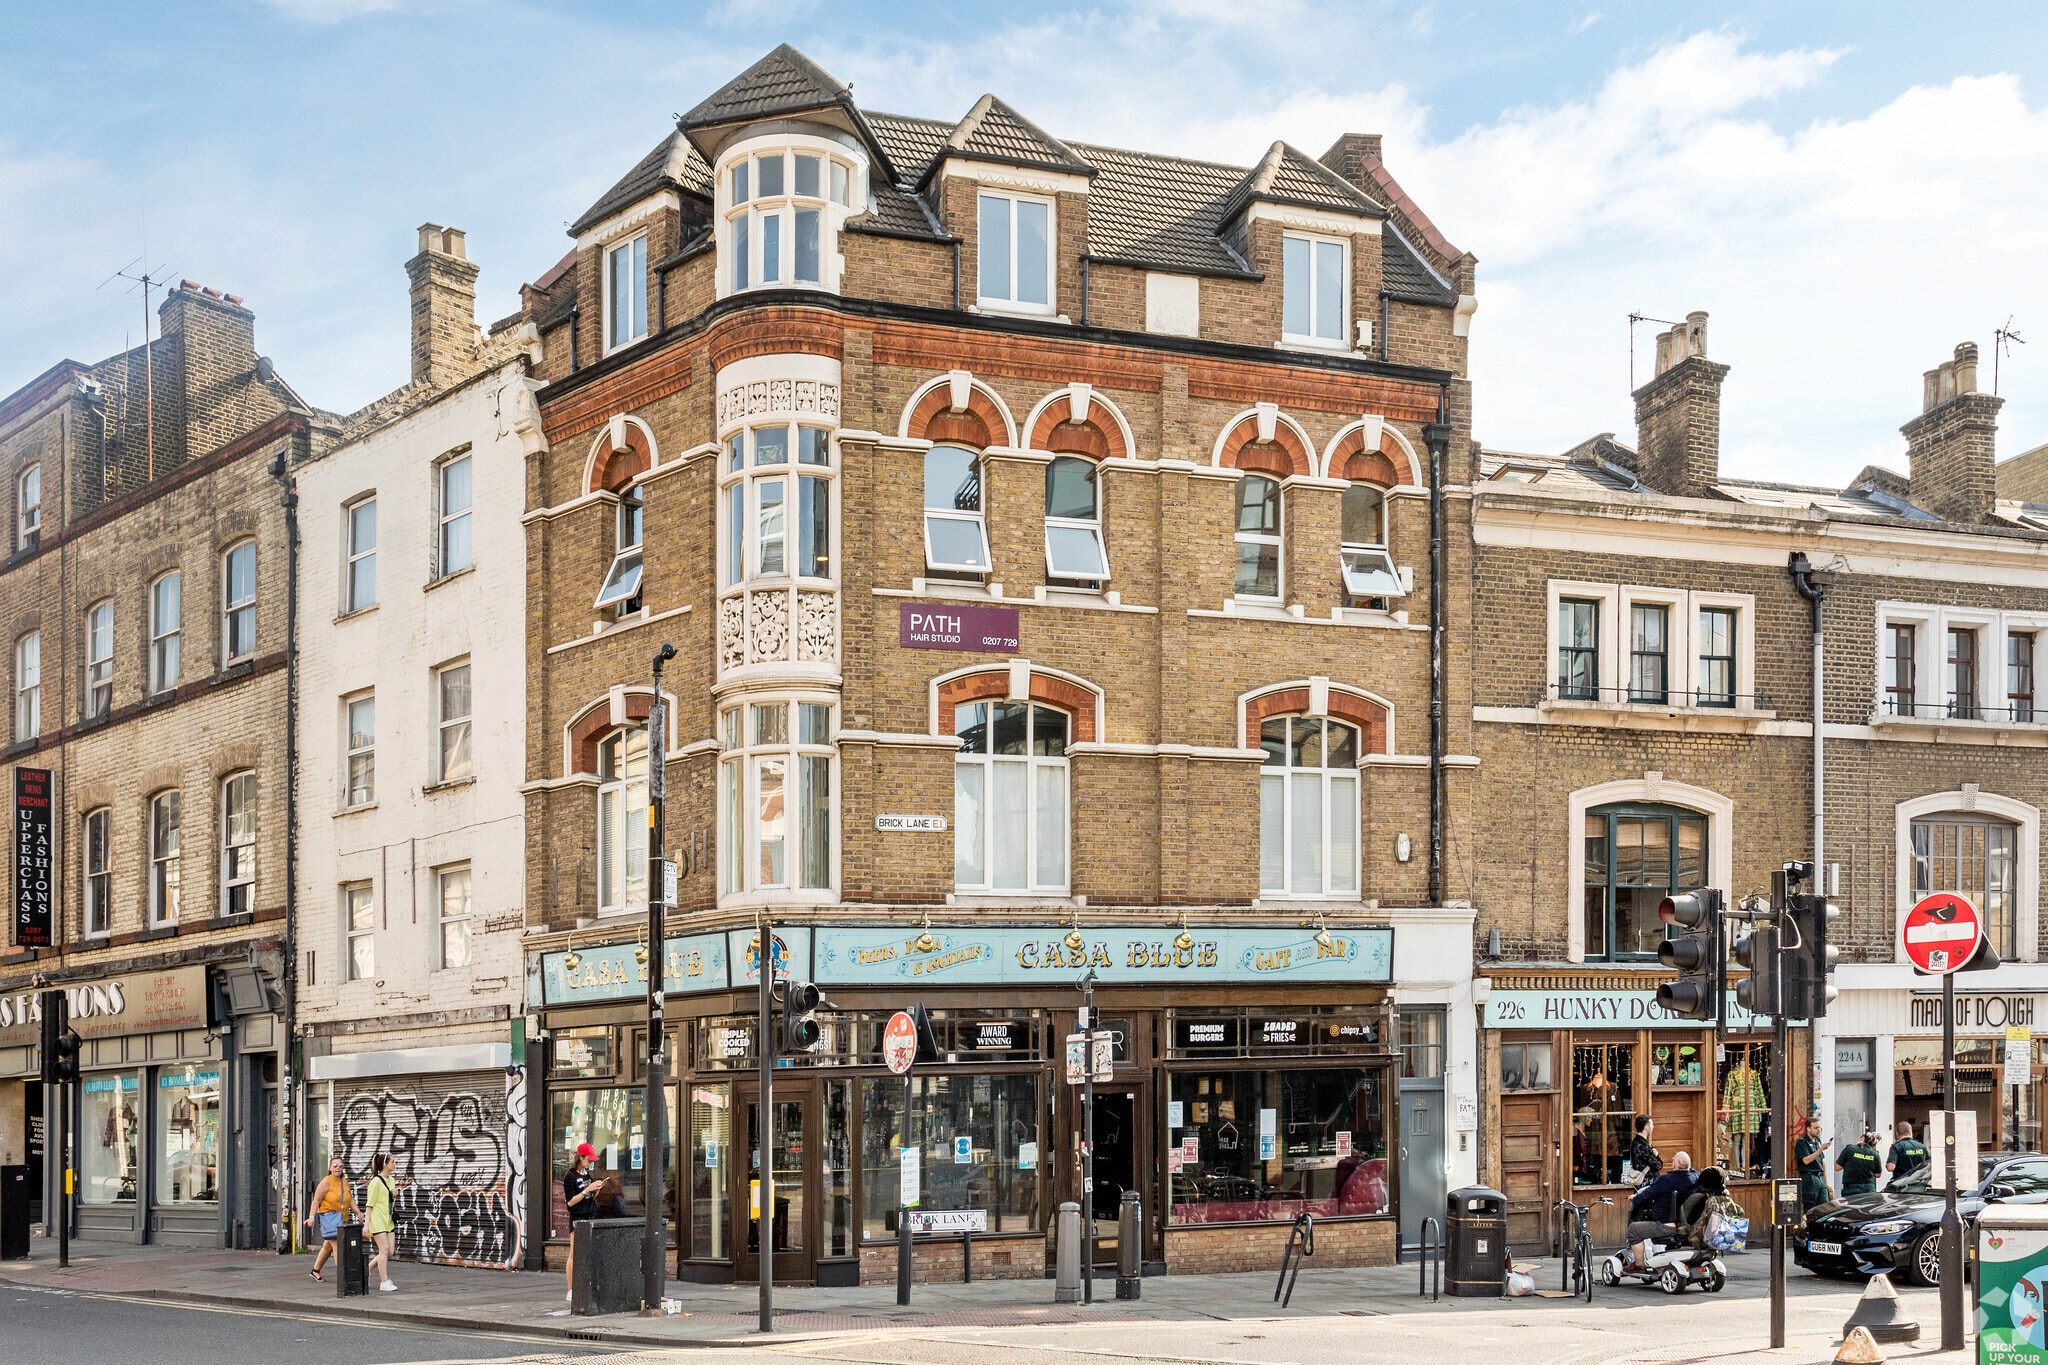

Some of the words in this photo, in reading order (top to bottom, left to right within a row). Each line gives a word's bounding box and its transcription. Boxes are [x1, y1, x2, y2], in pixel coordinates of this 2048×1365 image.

[911, 613, 961, 634] PATH
[911, 633, 930, 642] HAIR
[931, 634, 961, 644] STUDIO
[983, 636, 1001, 646] 0207
[1003, 637, 1018, 647] 729
[20, 771, 46, 783] LEATHER
[25, 784, 42, 795] SKINS
[18, 796, 49, 808] MERCHANT
[878, 818, 904, 828] BRICK
[906, 819, 930, 829] LANE
[20, 809, 33, 923] UPPERCLASS
[35, 823, 49, 914] FASHIONS
[1014, 941, 1113, 969] CASA
[1125, 941, 1219, 969] BLUE
[1255, 948, 1291, 971] CAFE
[1498, 1001, 1526, 1020] 226
[1544, 997, 1623, 1020] HUNKY
[1911, 998, 1943, 1027] MAD
[1955, 998, 1971, 1026] OF
[1976, 996, 2034, 1027] DOUGH
[980, 1025, 1008, 1038] AWARD
[1189, 1024, 1225, 1033] PREMIUM
[1263, 1022, 1297, 1032] LOADED
[1340, 1025, 1371, 1036] chipsy_uk
[718, 1038, 750, 1048] COOKED
[976, 1037, 1012, 1046] WINNING
[1189, 1033, 1225, 1042] BURGERS
[1270, 1032, 1290, 1043] FRIES
[723, 1047, 745, 1056] CHIPS
[908, 1214, 939, 1225] BRIK
[1989, 1342, 2016, 1352] PICK
[1989, 1352, 2005, 1362] UP
[2007, 1353, 2041, 1364] YOUR
